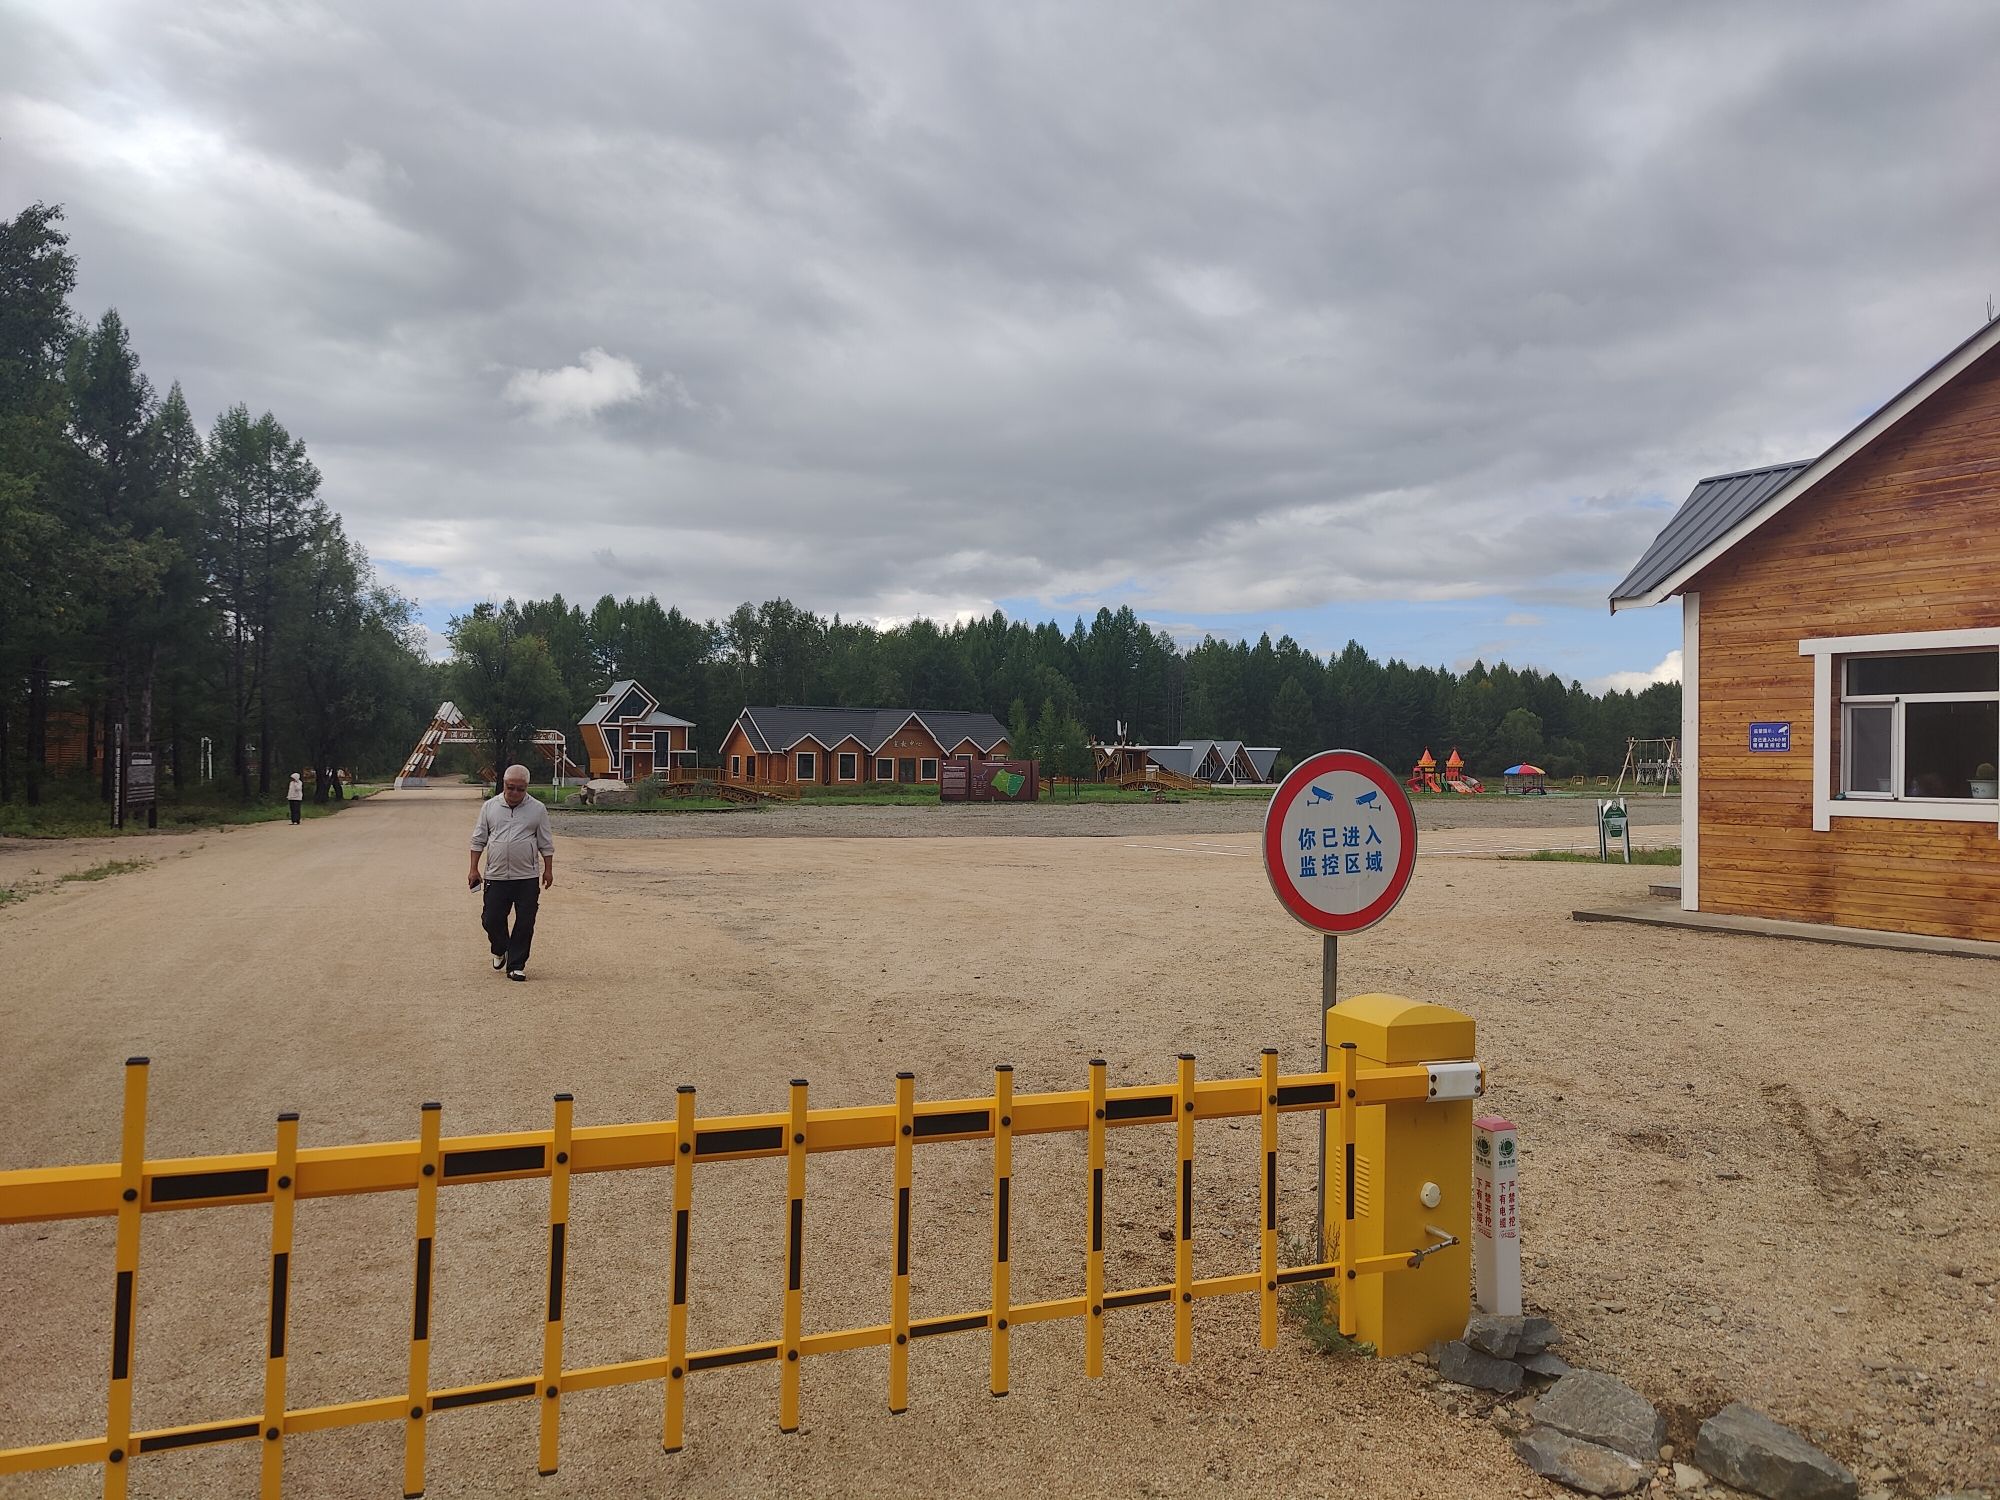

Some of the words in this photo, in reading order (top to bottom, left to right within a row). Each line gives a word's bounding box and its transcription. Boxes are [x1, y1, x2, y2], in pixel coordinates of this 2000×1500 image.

[1298, 825, 1382, 850] 你已进入
[1299, 850, 1383, 878] 监控区域
[1484, 1180, 1492, 1228] 严禁开挖
[1508, 1180, 1516, 1227] 严禁开挖
